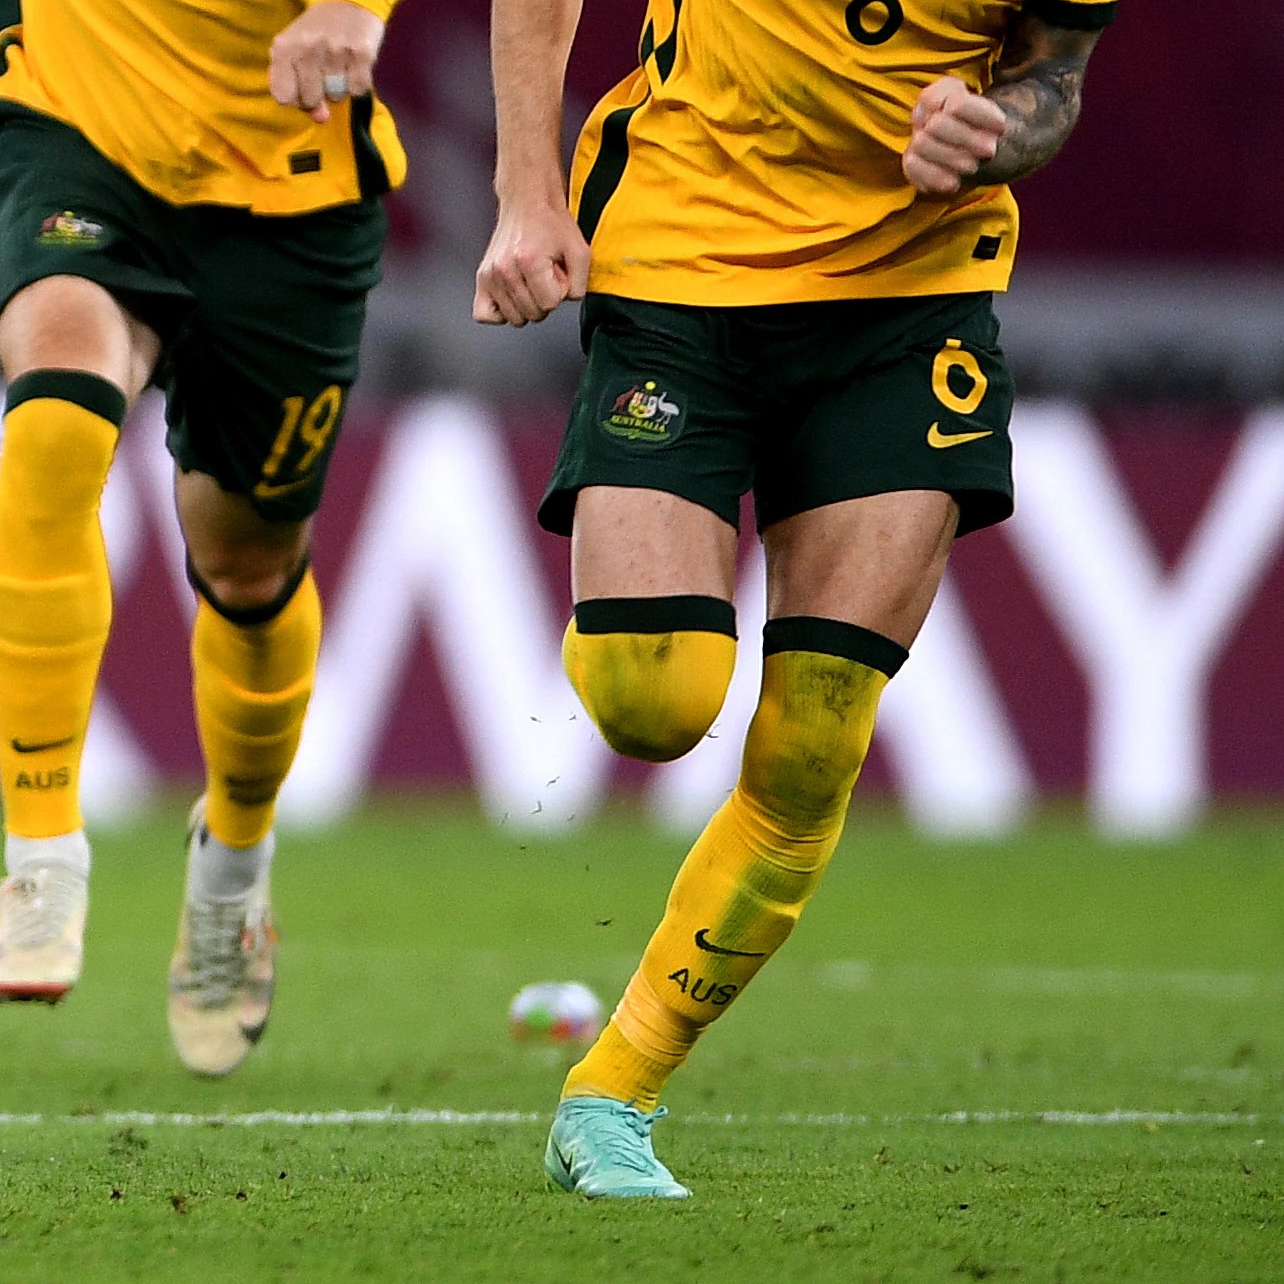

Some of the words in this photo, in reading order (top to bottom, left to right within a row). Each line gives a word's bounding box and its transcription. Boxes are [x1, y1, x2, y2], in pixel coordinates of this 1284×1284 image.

[261, 383, 343, 477] 19
[15, 766, 72, 791] AUS
[668, 968, 738, 1005] AUS
